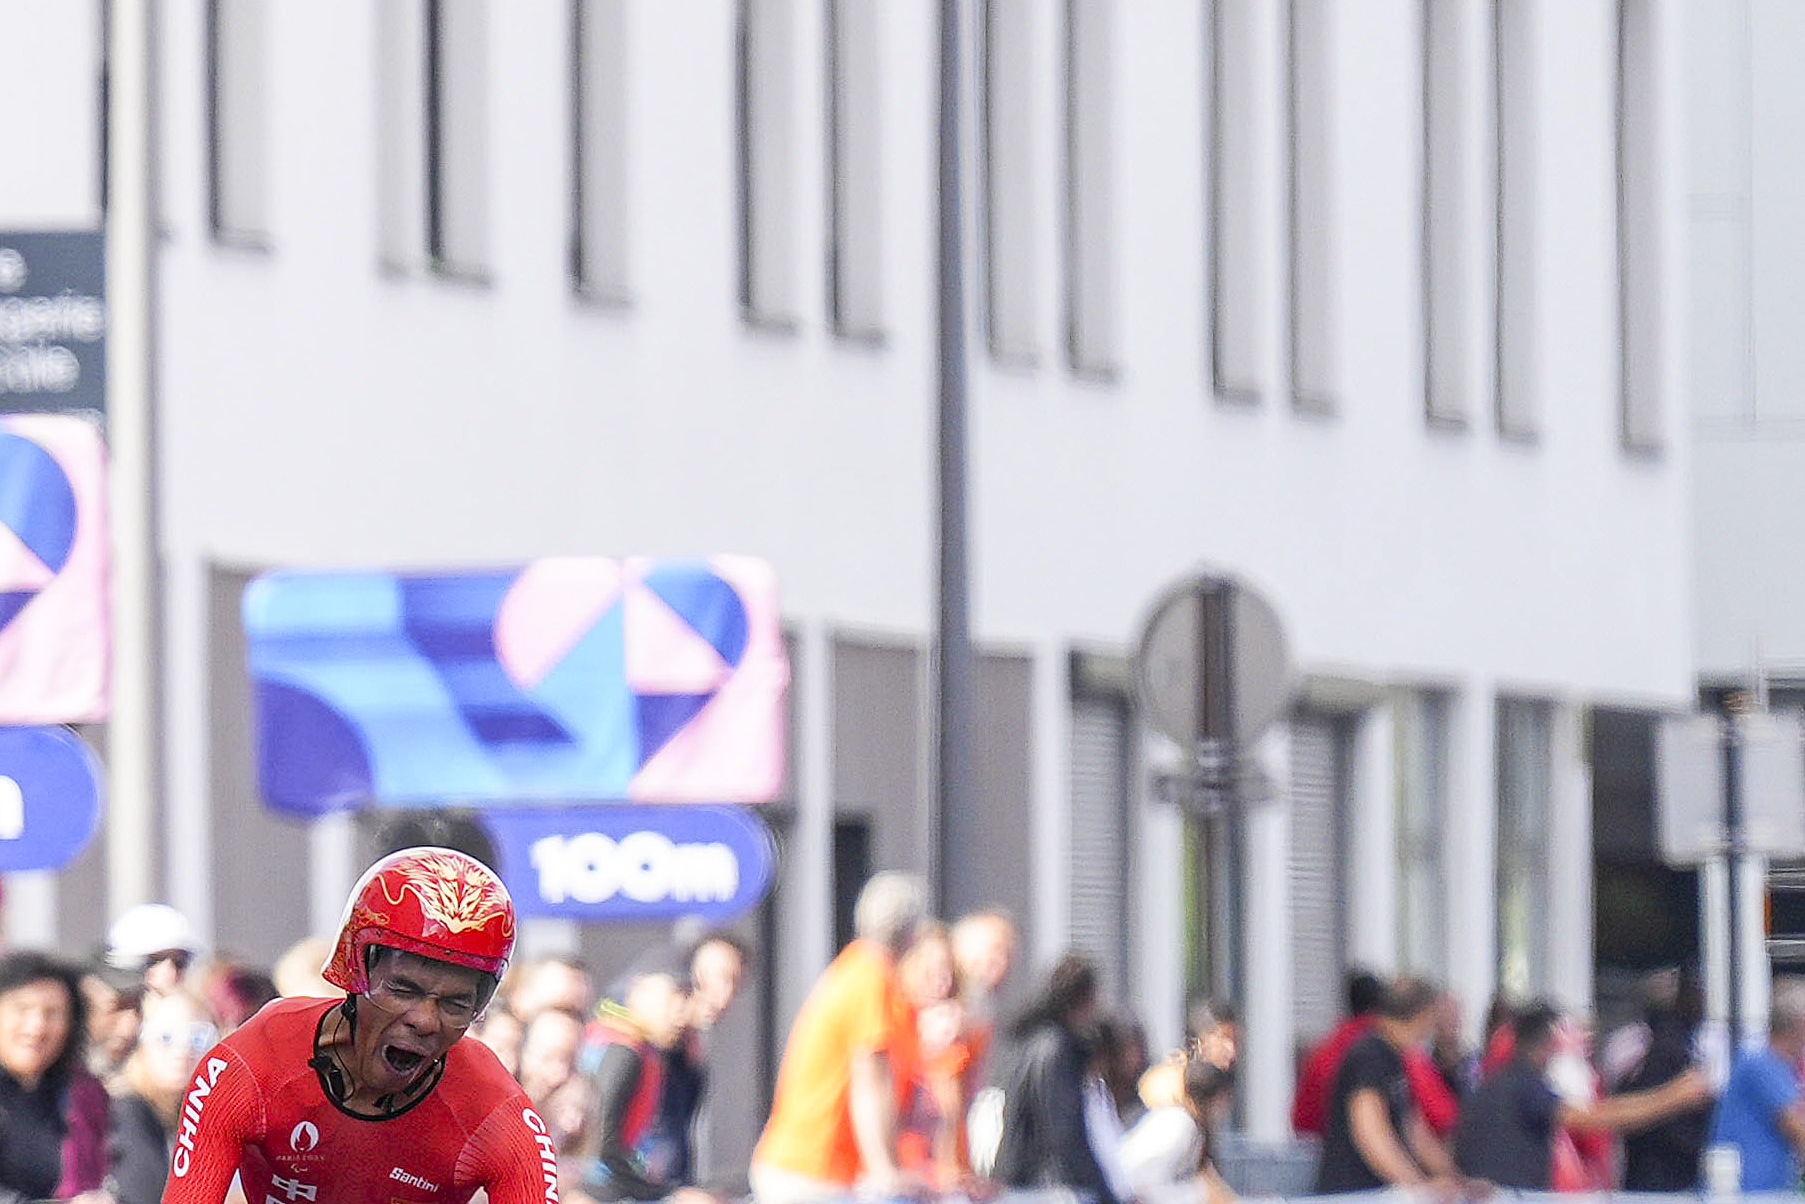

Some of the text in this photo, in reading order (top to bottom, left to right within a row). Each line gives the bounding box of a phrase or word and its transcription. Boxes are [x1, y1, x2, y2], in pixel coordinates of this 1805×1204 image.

[530, 831, 739, 903] 100m
[173, 1057, 229, 1177] CHINA
[389, 1166, 440, 1193] Santini
